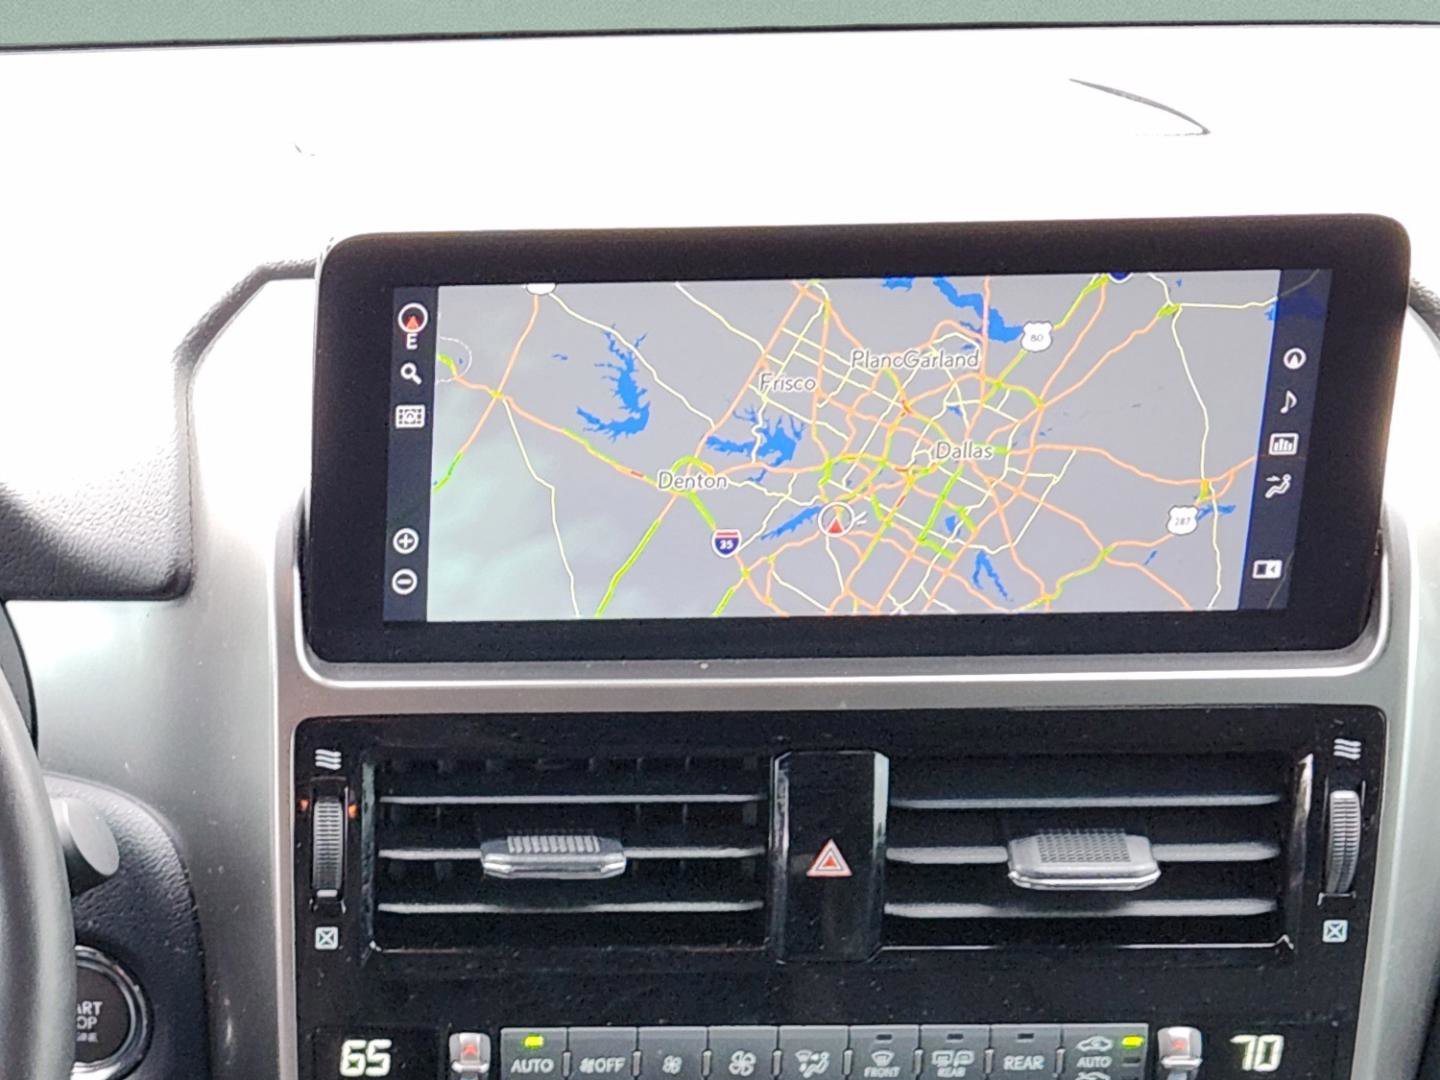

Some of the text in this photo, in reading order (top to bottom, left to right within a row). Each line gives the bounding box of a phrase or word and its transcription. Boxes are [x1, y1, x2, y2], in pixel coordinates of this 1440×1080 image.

[406, 333, 418, 350] E
[903, 350, 980, 369] Garland
[760, 372, 817, 392] Frisco
[936, 441, 993, 460] Dallas
[658, 470, 729, 491] Denton
[339, 1038, 392, 1077] 65
[1230, 1034, 1284, 1072] 70
[510, 1058, 554, 1074] AUTO
[594, 1057, 625, 1074] OFF
[1003, 1055, 1045, 1071] REAR
[1076, 1056, 1112, 1069] AUTO
[864, 1066, 900, 1078] FRONT
